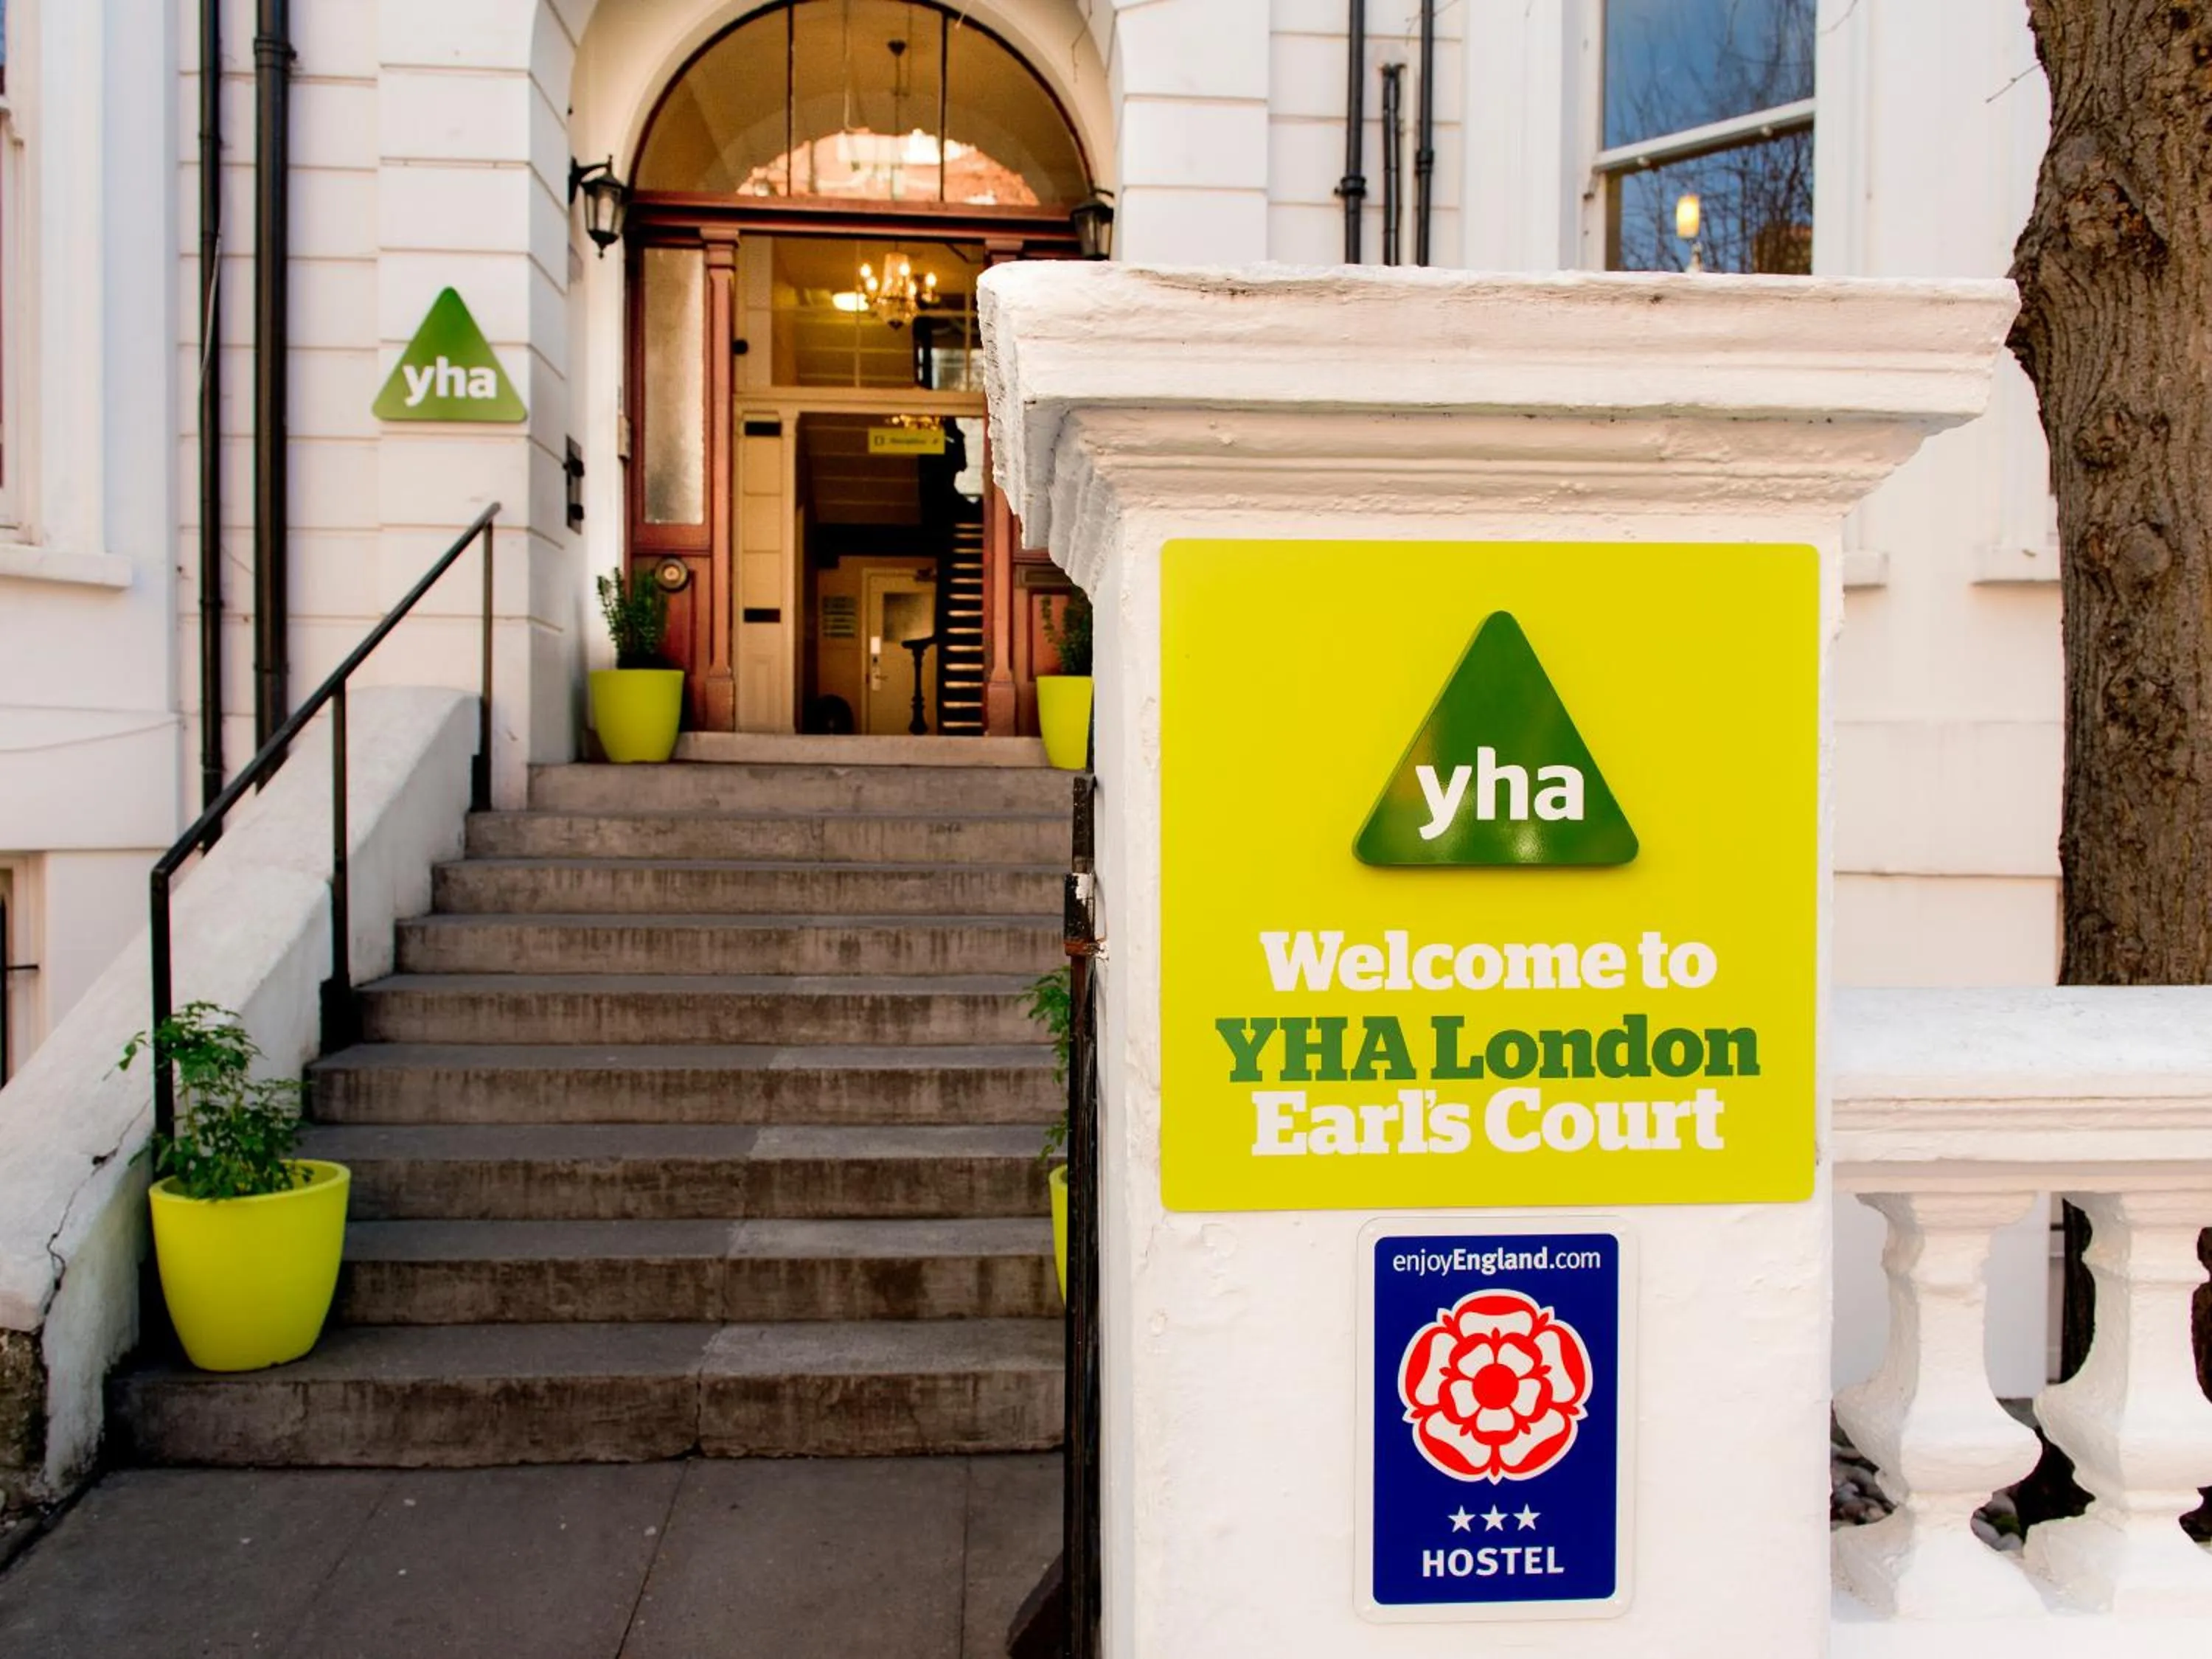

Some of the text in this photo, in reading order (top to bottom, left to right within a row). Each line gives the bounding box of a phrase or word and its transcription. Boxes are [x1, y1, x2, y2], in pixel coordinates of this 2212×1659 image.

[403, 355, 497, 407] yha
[1415, 746, 1584, 840] yha
[1259, 930, 1718, 992] Welcome to
[1215, 1013, 1761, 1082] YHA London
[1251, 1087, 1725, 1156] Earl's Court
[1392, 1246, 1601, 1276] enjoyEngland.com
[1422, 1545, 1565, 1577] HOSTEL
